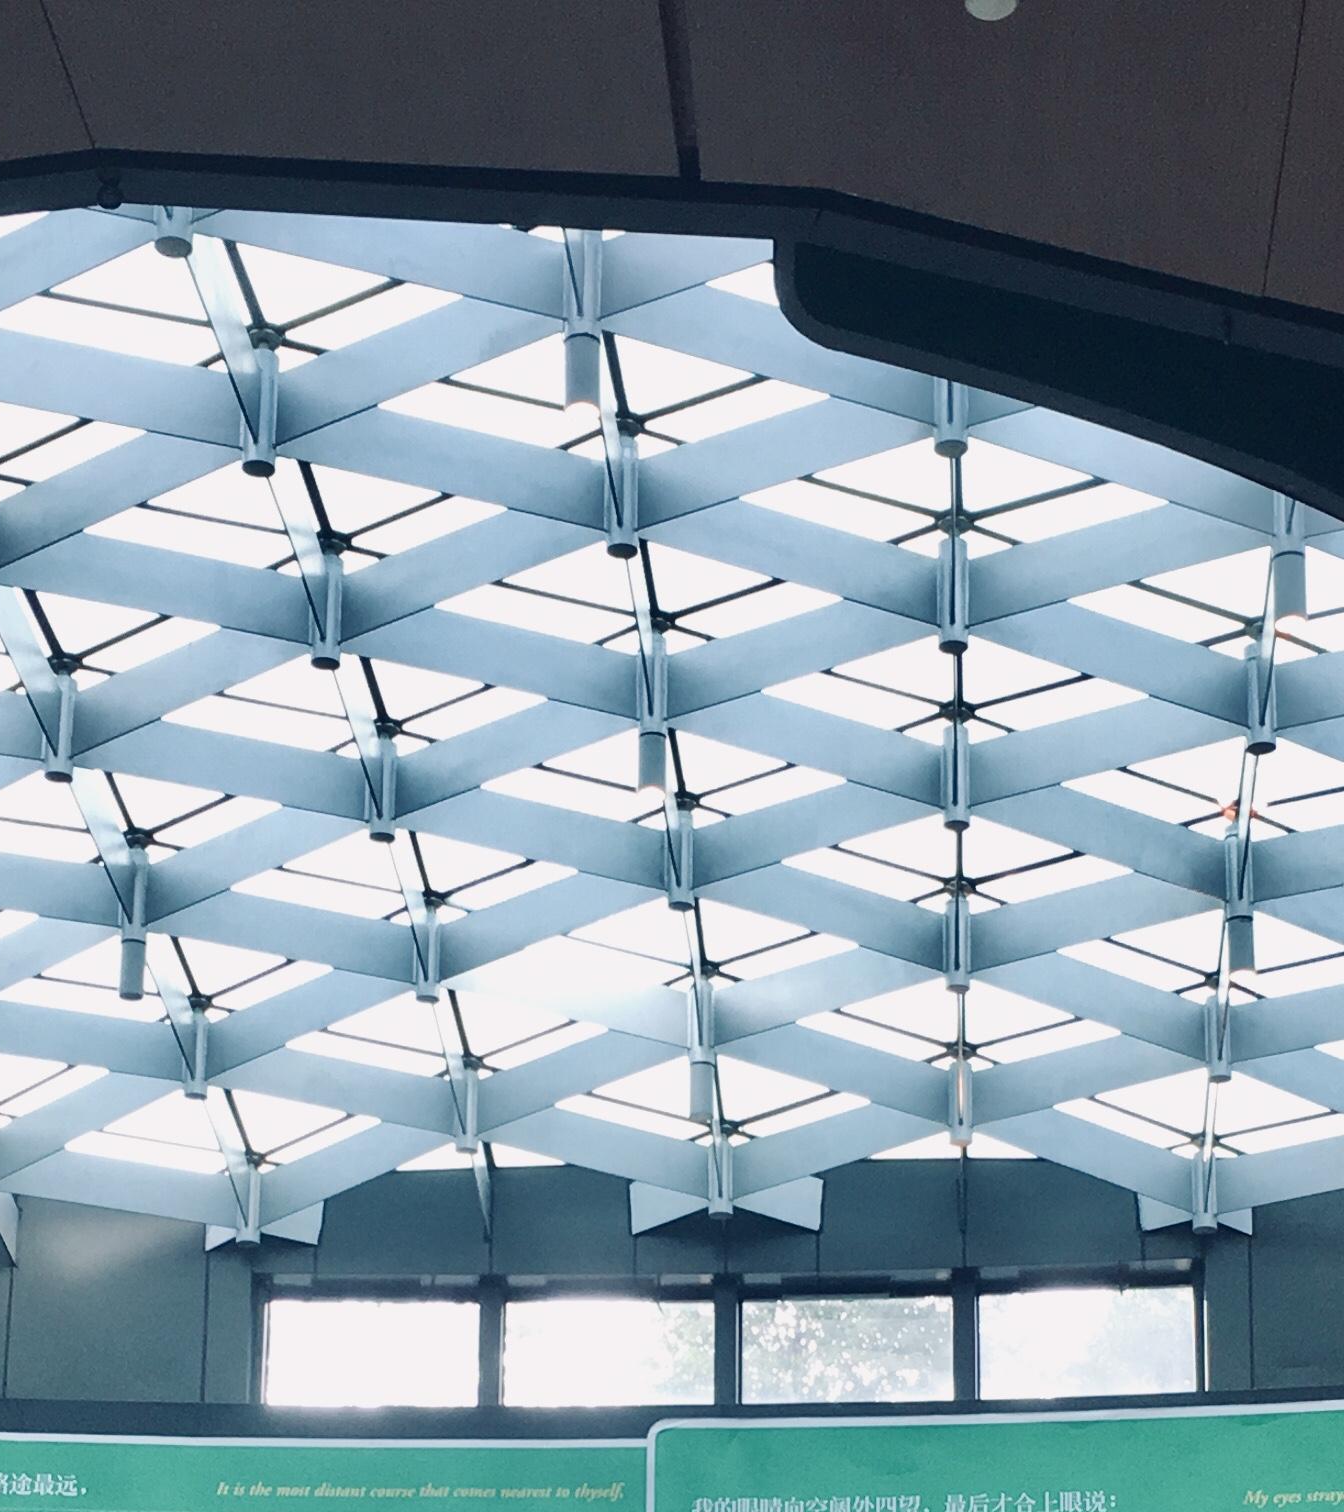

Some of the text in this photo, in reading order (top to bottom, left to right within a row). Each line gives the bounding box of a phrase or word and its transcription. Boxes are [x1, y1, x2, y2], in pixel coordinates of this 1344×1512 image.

[215, 1480, 624, 1501] It is the most distant course that comes nearest to thyself,
[1242, 1489, 1269, 1508] My
[1272, 1492, 1302, 1508] eyes
